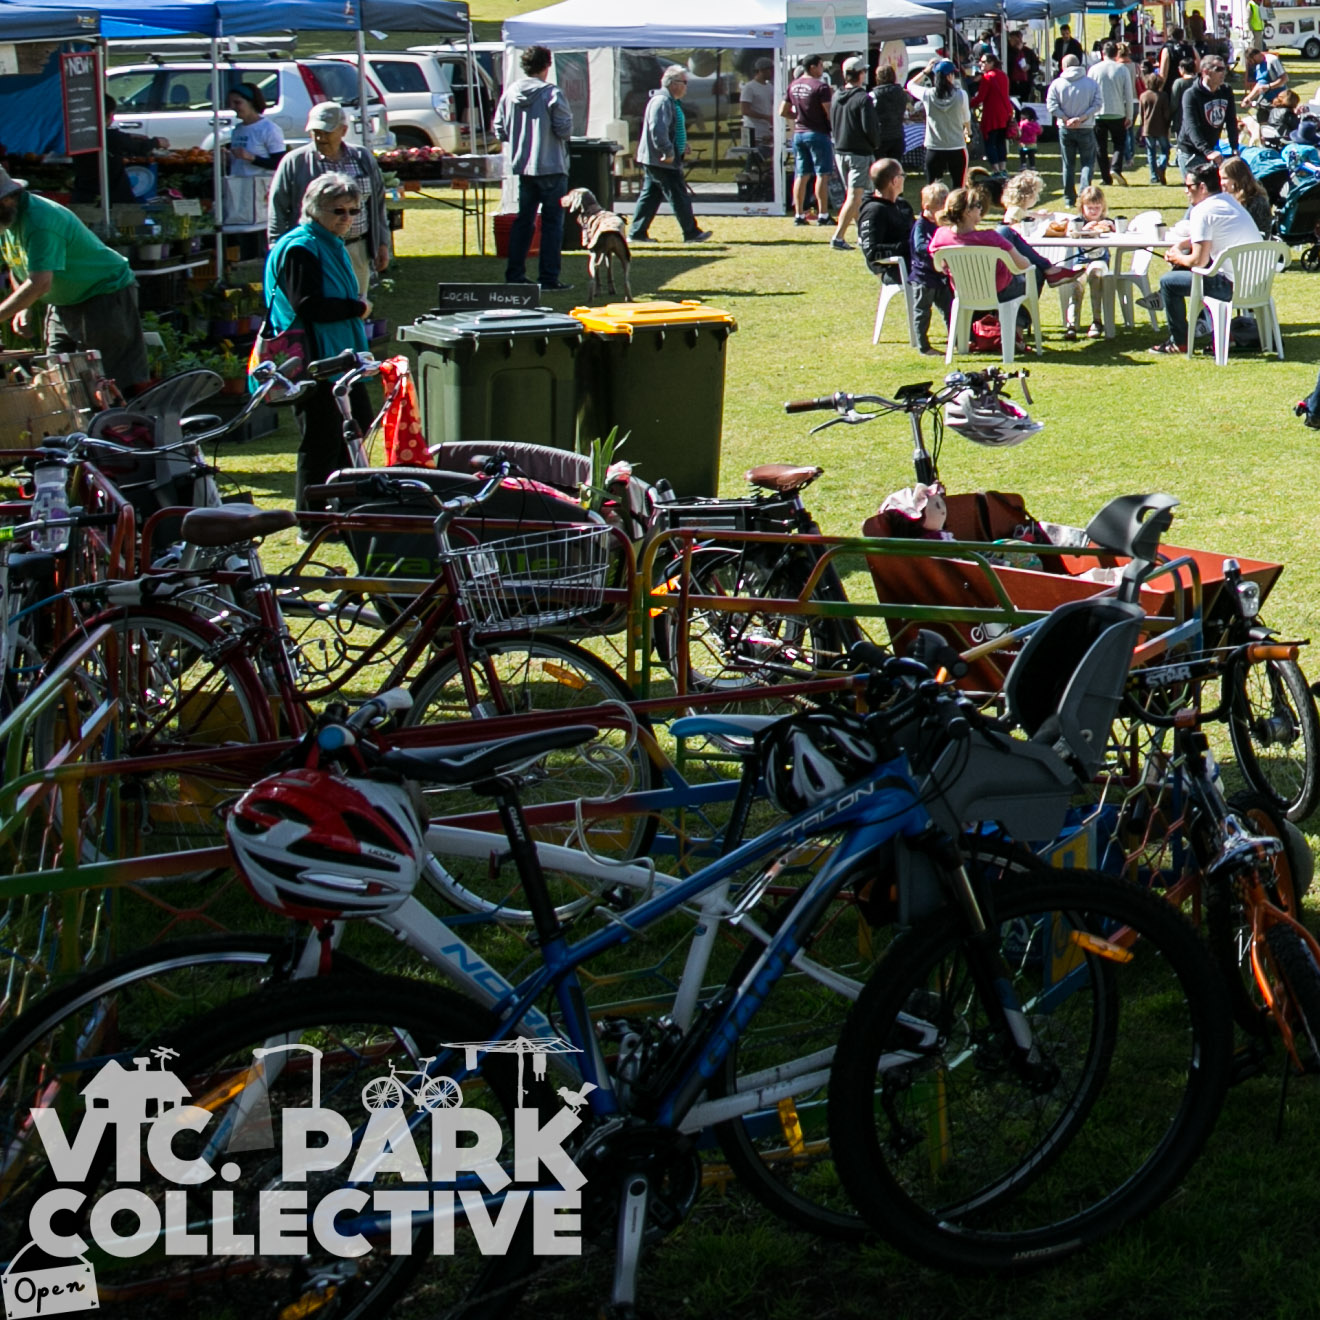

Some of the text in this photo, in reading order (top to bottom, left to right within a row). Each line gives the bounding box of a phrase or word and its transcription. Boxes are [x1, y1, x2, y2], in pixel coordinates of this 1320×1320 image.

[68, 56, 90, 77] NEW
[442, 291, 532, 305] LOCAL HONEY
[508, 805, 527, 842] GIANT
[781, 781, 874, 838] TALON
